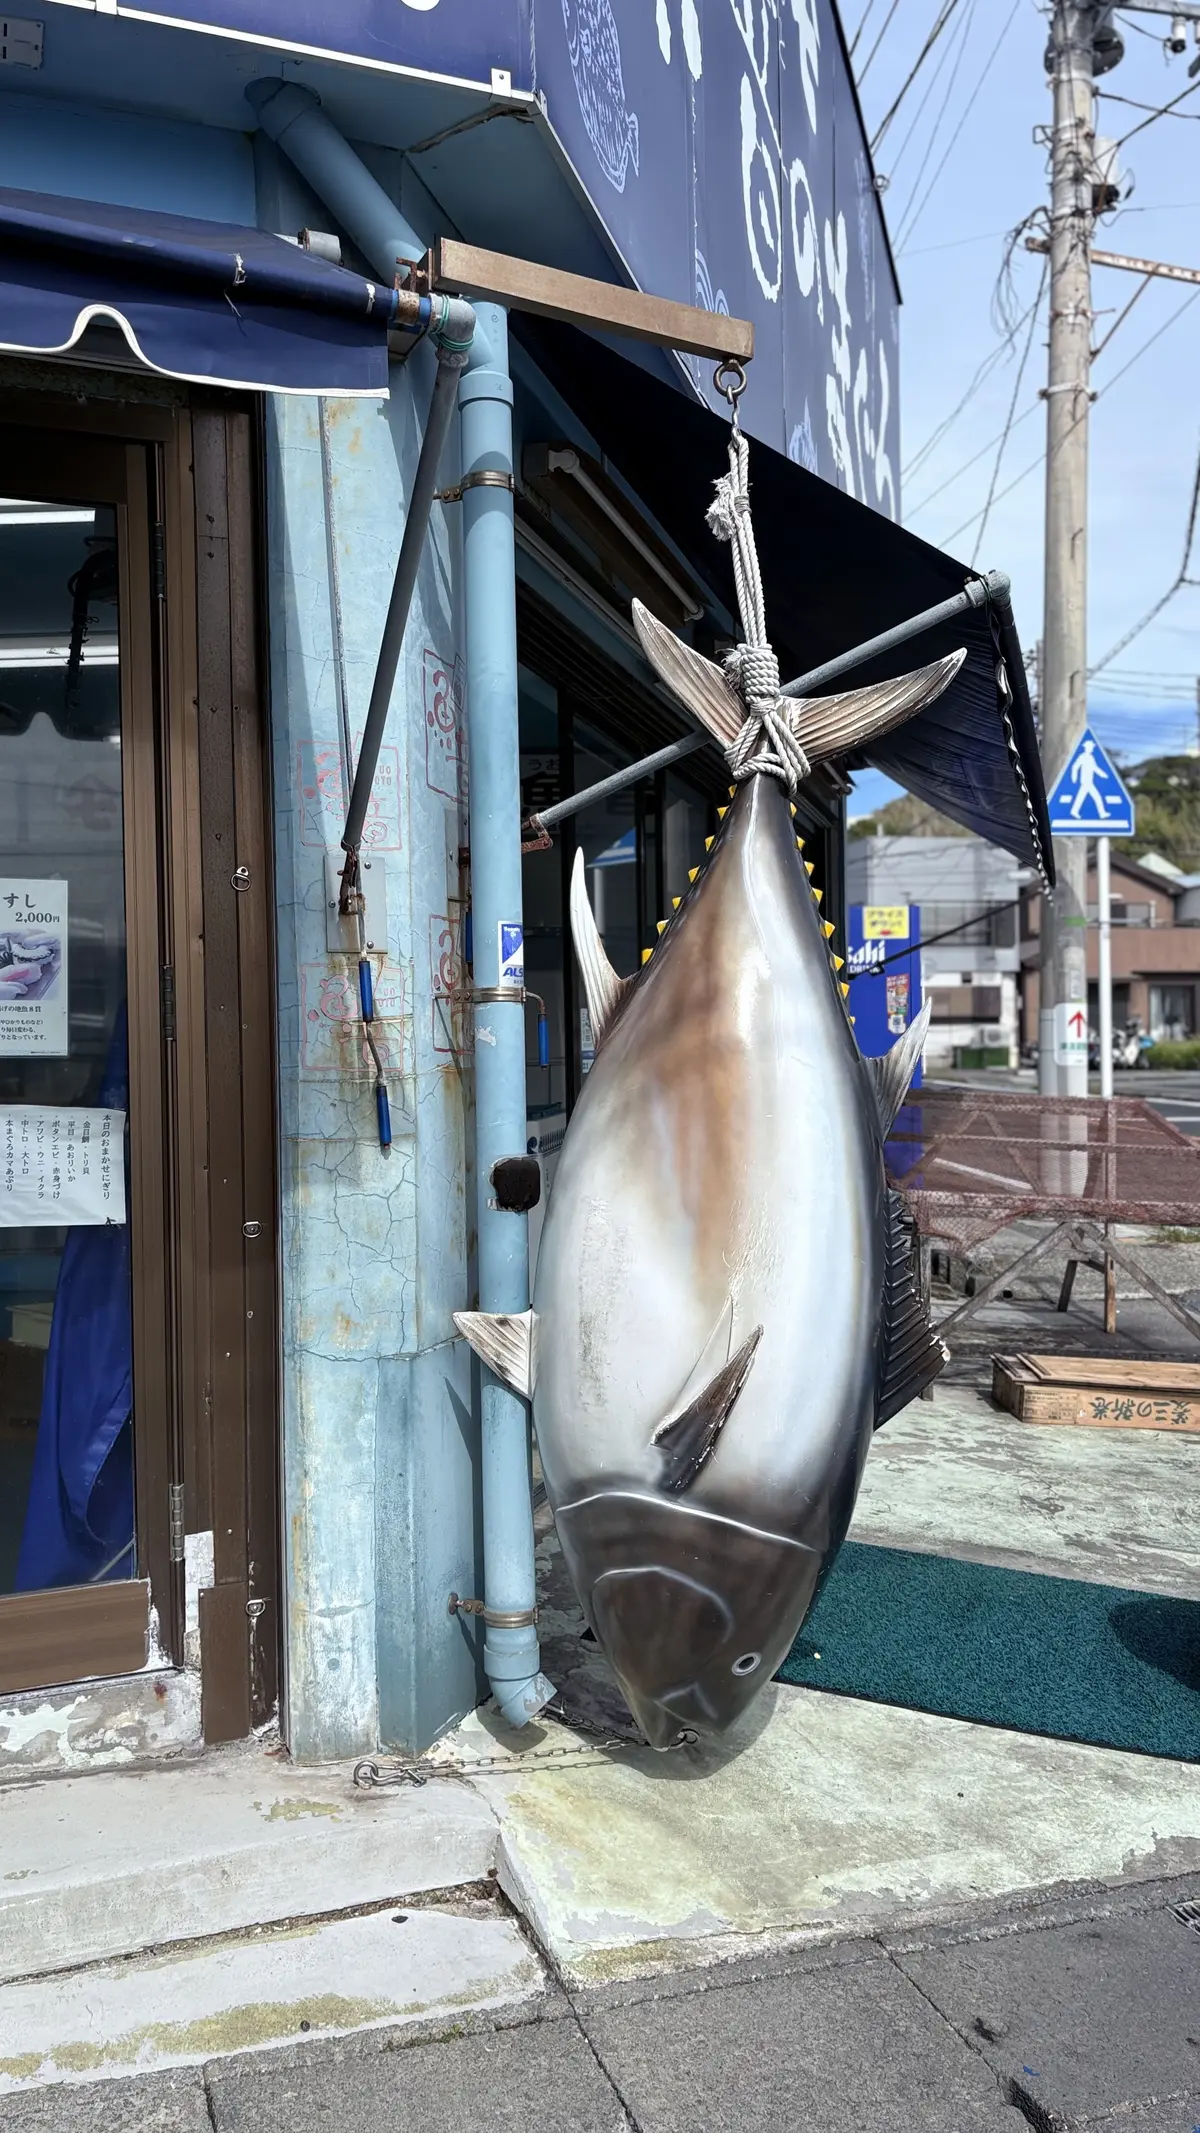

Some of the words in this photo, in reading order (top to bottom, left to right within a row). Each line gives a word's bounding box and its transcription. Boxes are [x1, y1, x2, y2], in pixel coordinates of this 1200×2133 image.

[2, 892, 37, 909] すし
[15, 911, 60, 924] 2,000円
[101, 1114, 111, 1200] 本日のおまかせにぎり
